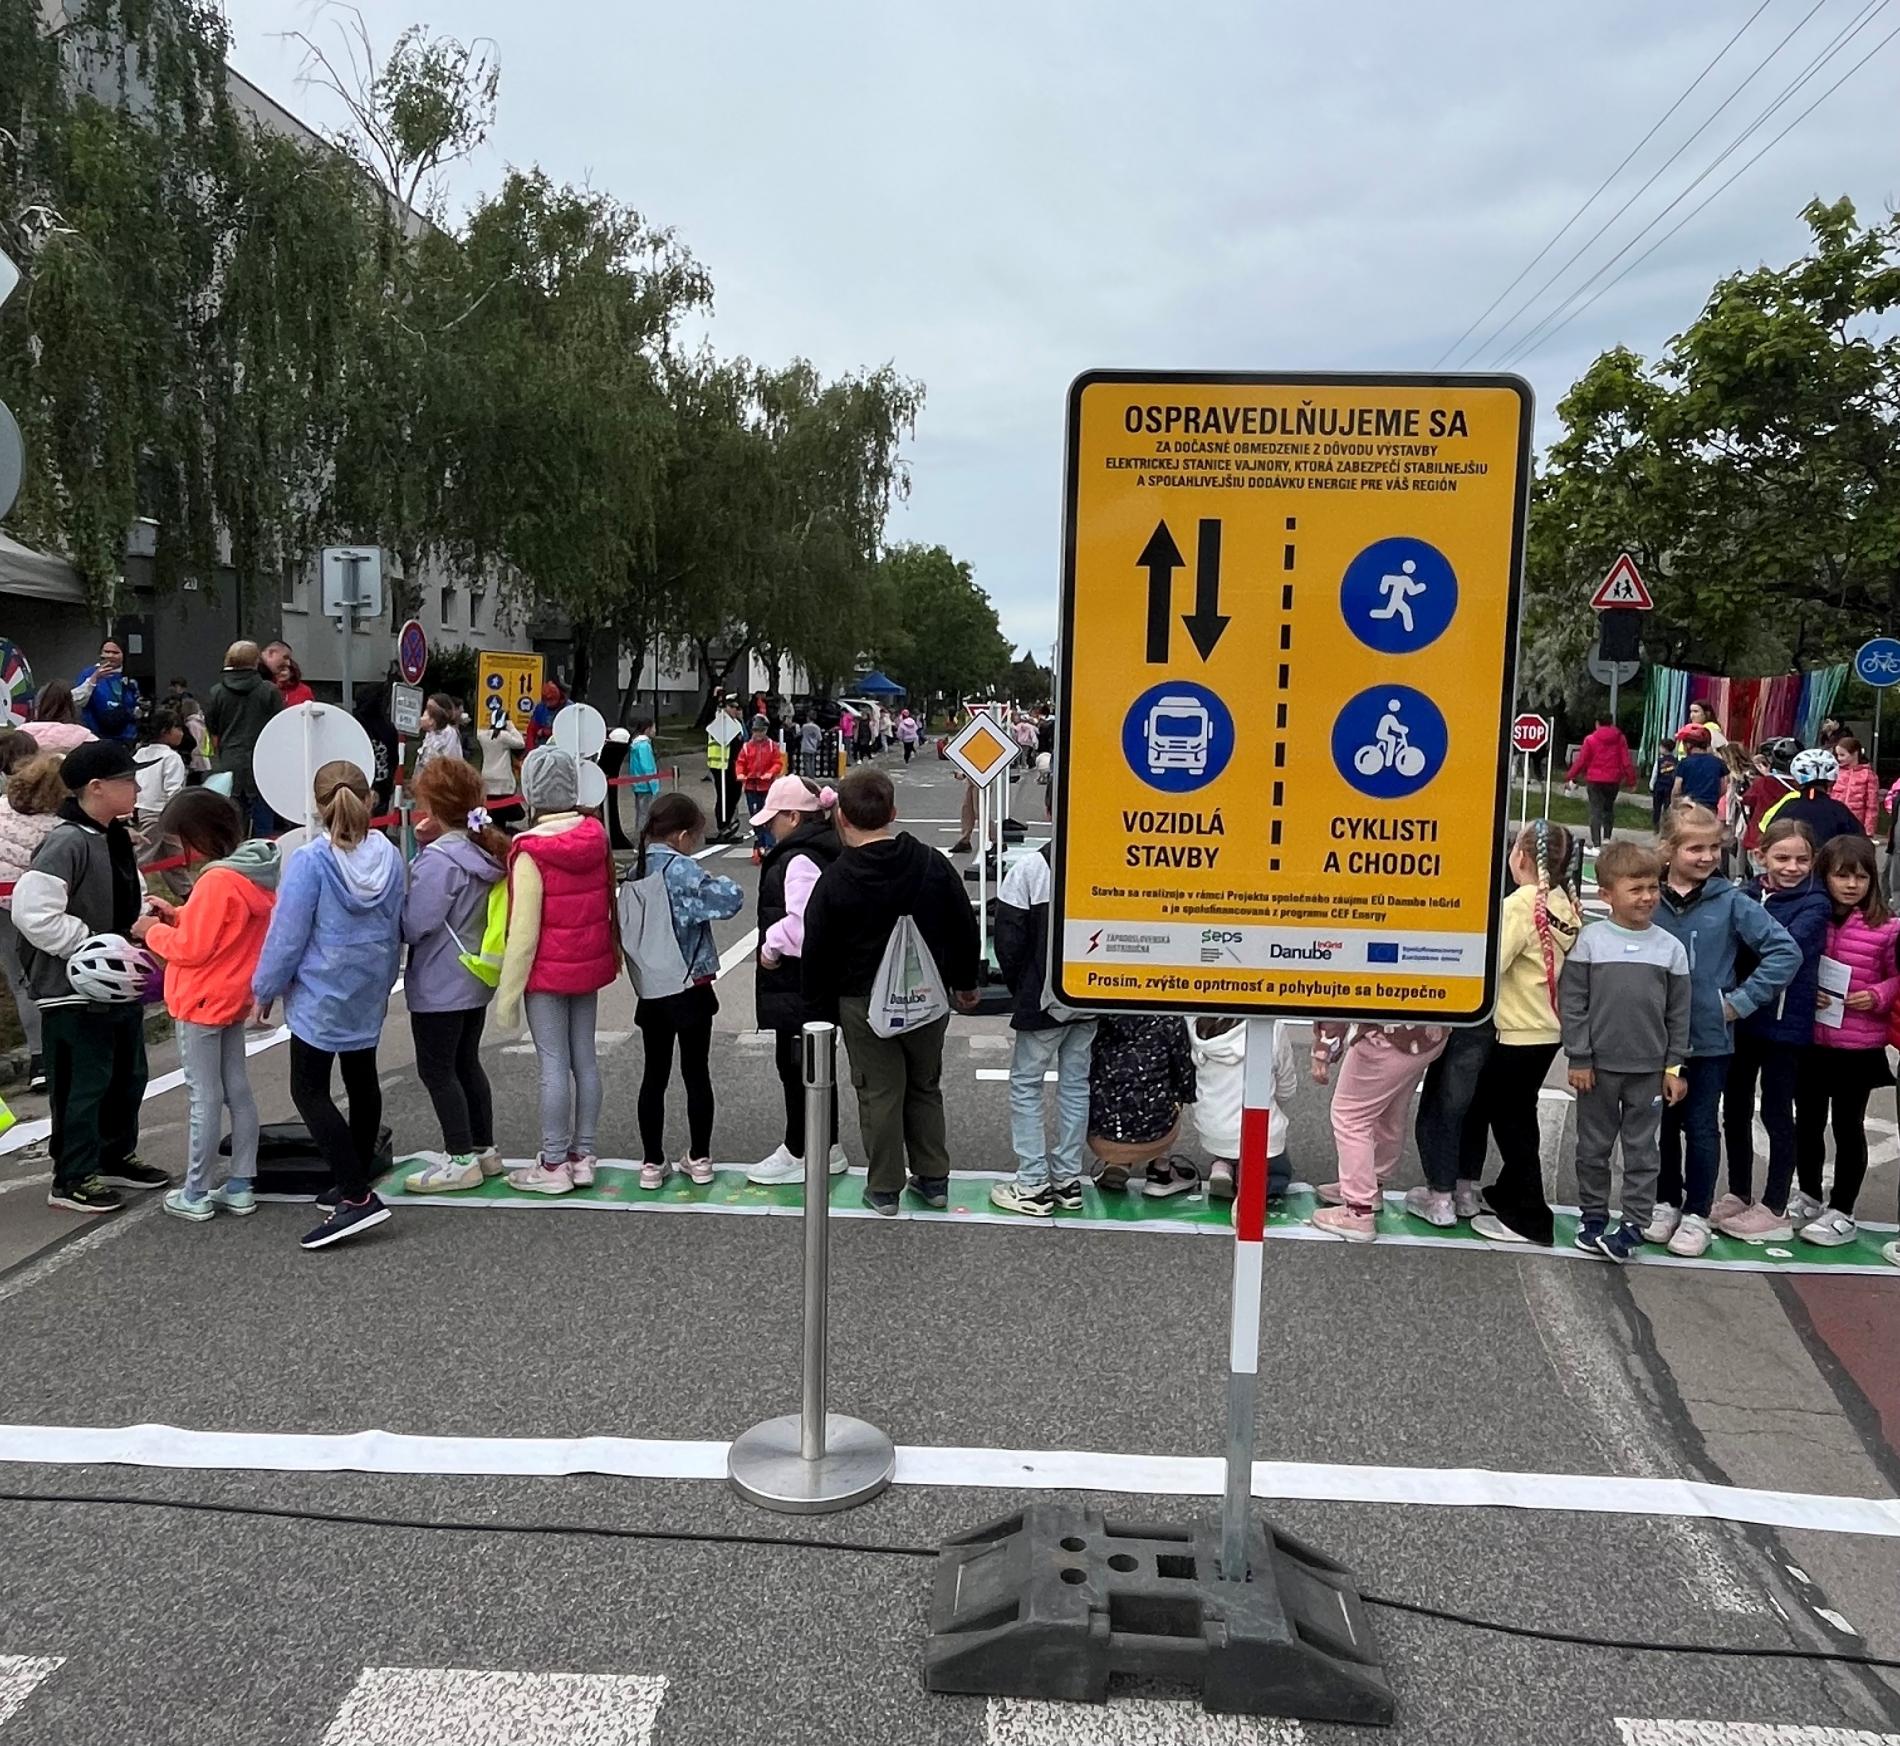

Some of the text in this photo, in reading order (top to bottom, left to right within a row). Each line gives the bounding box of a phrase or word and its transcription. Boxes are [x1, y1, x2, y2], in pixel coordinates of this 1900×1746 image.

[1125, 400, 1468, 437] OSPRAVEDLŇUJEME SA
[1156, 439, 1438, 457] ZA DOČASNÉ OBMEDZENIE Z DÔVODU VÝSTAVBY
[1106, 457, 1488, 475] ELEKTRICKEJ STANICE VAJNORY, KTORÁ ZABEZPEČÍ STABILNEJŠIU
[1136, 475, 1145, 486] A
[1248, 475, 1304, 489] DODÁVKU
[1308, 478, 1356, 490] ENERGIE
[1361, 479, 1383, 490] PRE
[1386, 476, 1409, 491] VÁŠ
[1413, 478, 1457, 492] REGIÓN
[1513, 725, 1545, 740] STOP
[1123, 808, 1225, 835] VOZIDLÁ
[1330, 817, 1437, 842] CYKLISTI
[1126, 844, 1220, 868] STAVBY
[1323, 851, 1440, 876] A CHODCI
[1091, 886, 1125, 897] Stavba
[1128, 889, 1139, 898] sa
[1142, 888, 1185, 900] realizuje
[1188, 891, 1193, 899] v
[1196, 889, 1225, 900] rámci
[1227, 891, 1268, 903] Projektu
[1272, 892, 1329, 904] spoločného
[1371, 894, 1384, 905] EÚ
[1162, 905, 1168, 913] a
[1170, 903, 1180, 914] je
[1280, 909, 1328, 920] programu
[1331, 908, 1349, 919] CEF
[1352, 909, 1386, 922] Energy
[1270, 941, 1332, 961] Danube
[1087, 972, 1446, 1002] Prosím, zvýšte opatrnosť a pohybujte sa bezpečne
